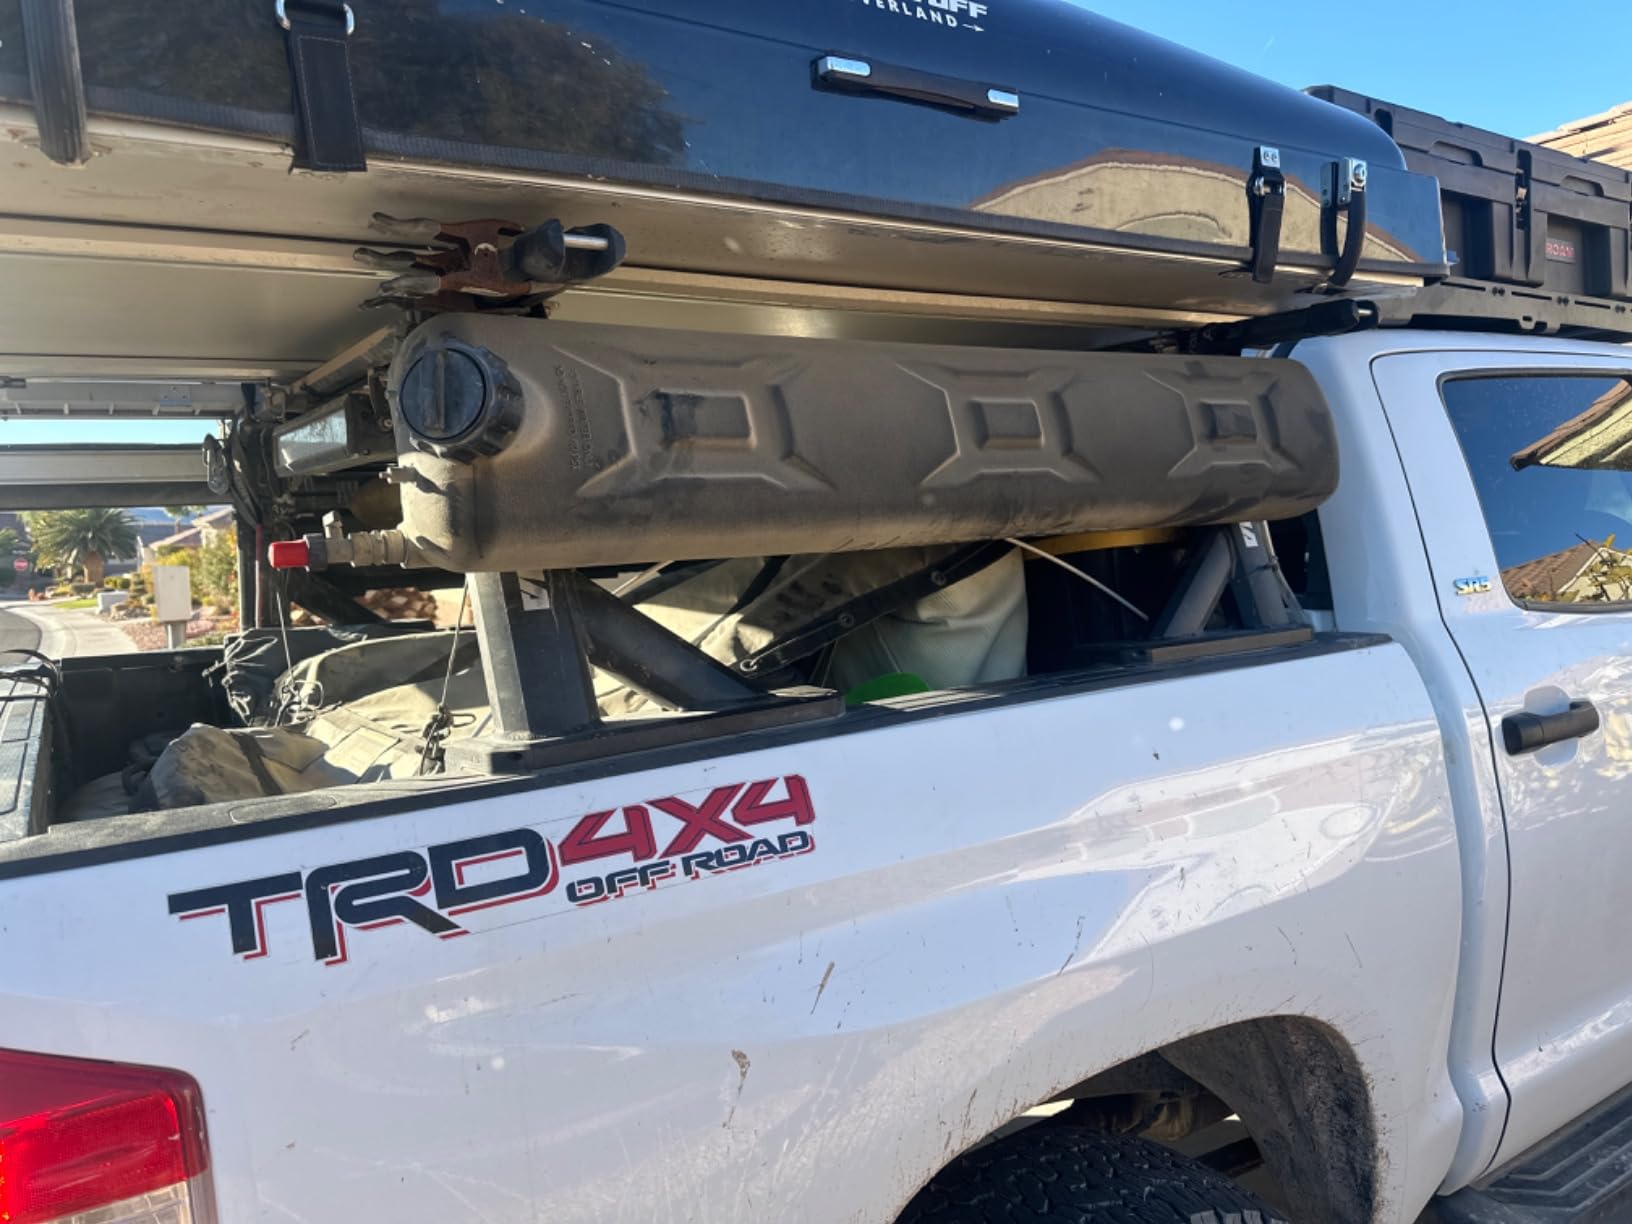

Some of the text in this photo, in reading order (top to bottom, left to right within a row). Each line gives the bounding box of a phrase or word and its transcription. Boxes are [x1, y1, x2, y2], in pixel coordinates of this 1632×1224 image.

[913, 0, 988, 18] UFF
[168, 828, 559, 966] TRD
[566, 830, 816, 906] OFF ROAD
